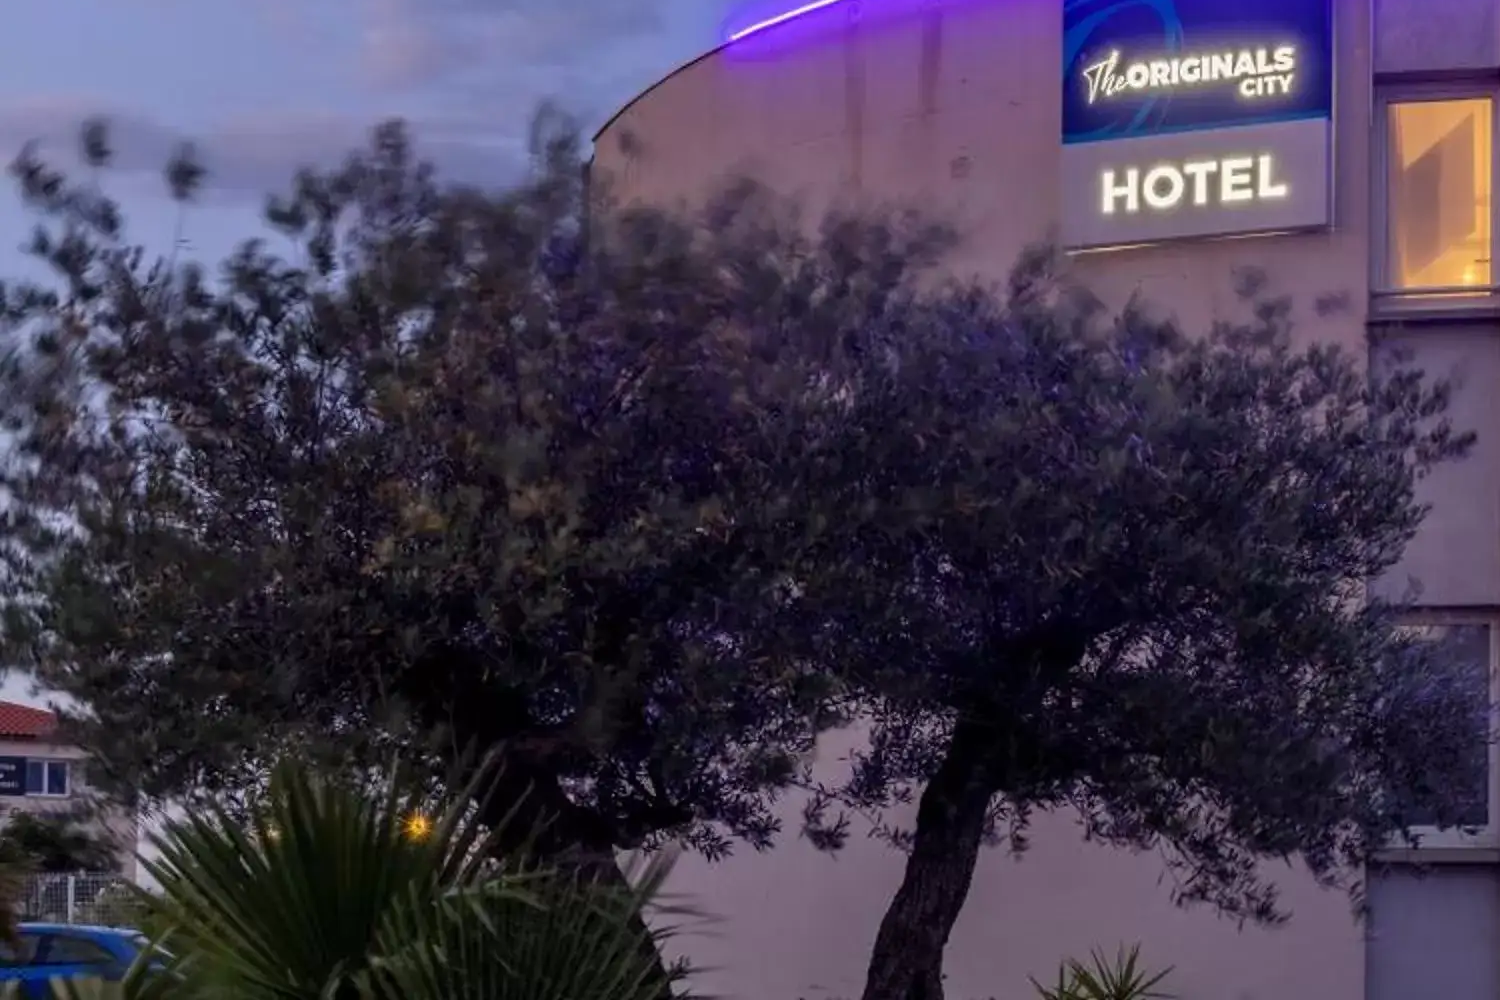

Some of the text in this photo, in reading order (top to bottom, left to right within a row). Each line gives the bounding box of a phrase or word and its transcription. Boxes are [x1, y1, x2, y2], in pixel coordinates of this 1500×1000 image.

[1084, 47, 1296, 104] The ORIGINALS
[1240, 75, 1294, 97] CITY
[1102, 155, 1288, 214] HOTEL
